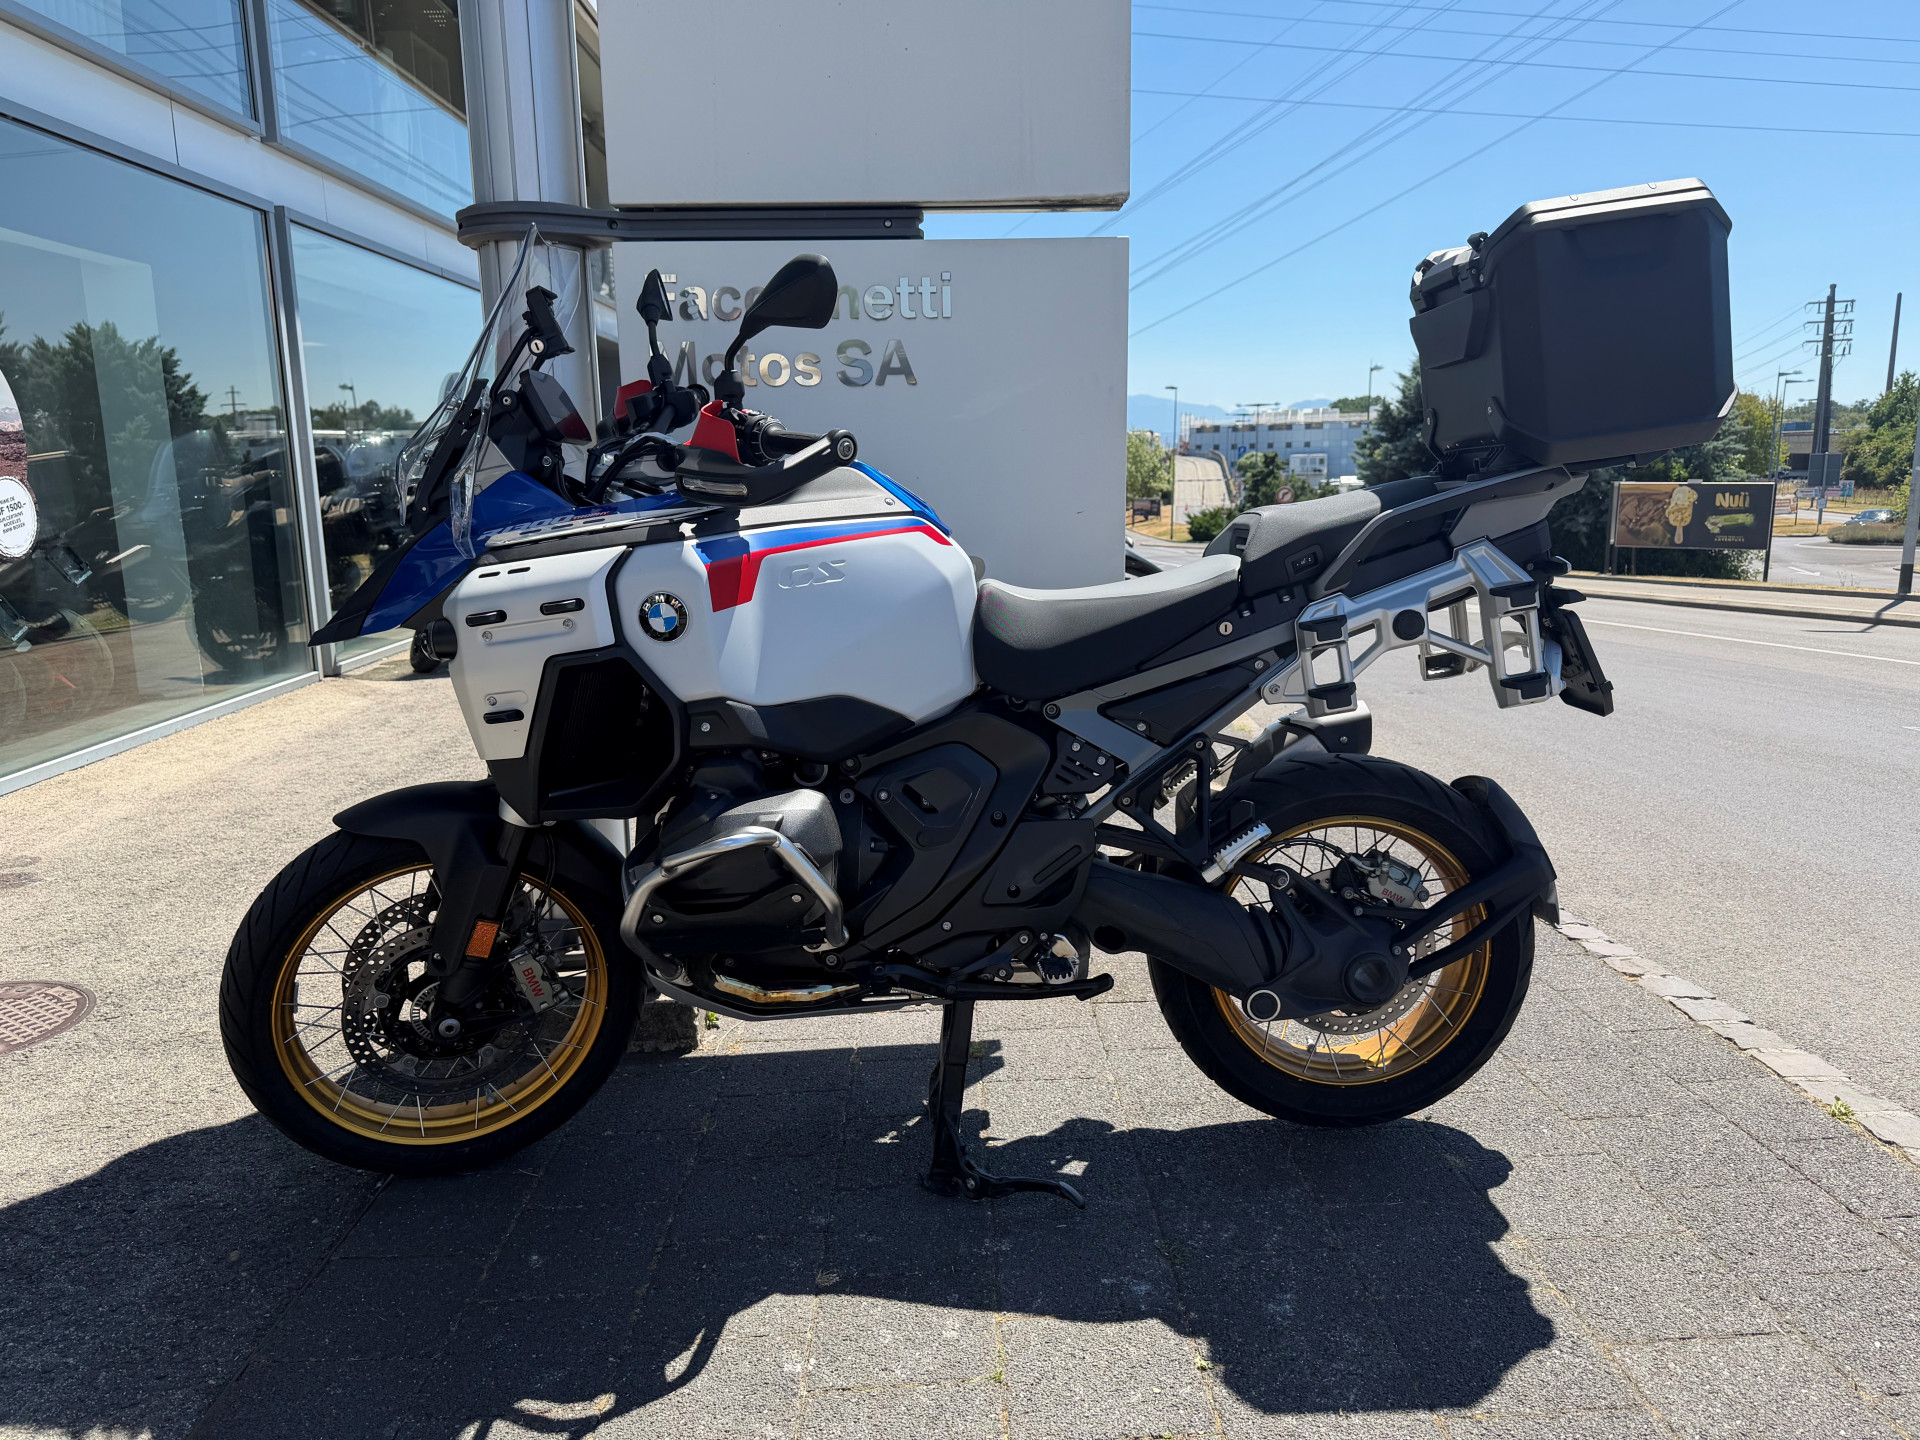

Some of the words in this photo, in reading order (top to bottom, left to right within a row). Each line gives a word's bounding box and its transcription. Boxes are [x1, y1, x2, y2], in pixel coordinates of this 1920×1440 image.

[836, 339, 917, 387] SA
[778, 559, 846, 589] GS
[644, 594, 682, 612] BMW
[1381, 888, 1406, 904] BMW
[522, 967, 545, 997] BMW
